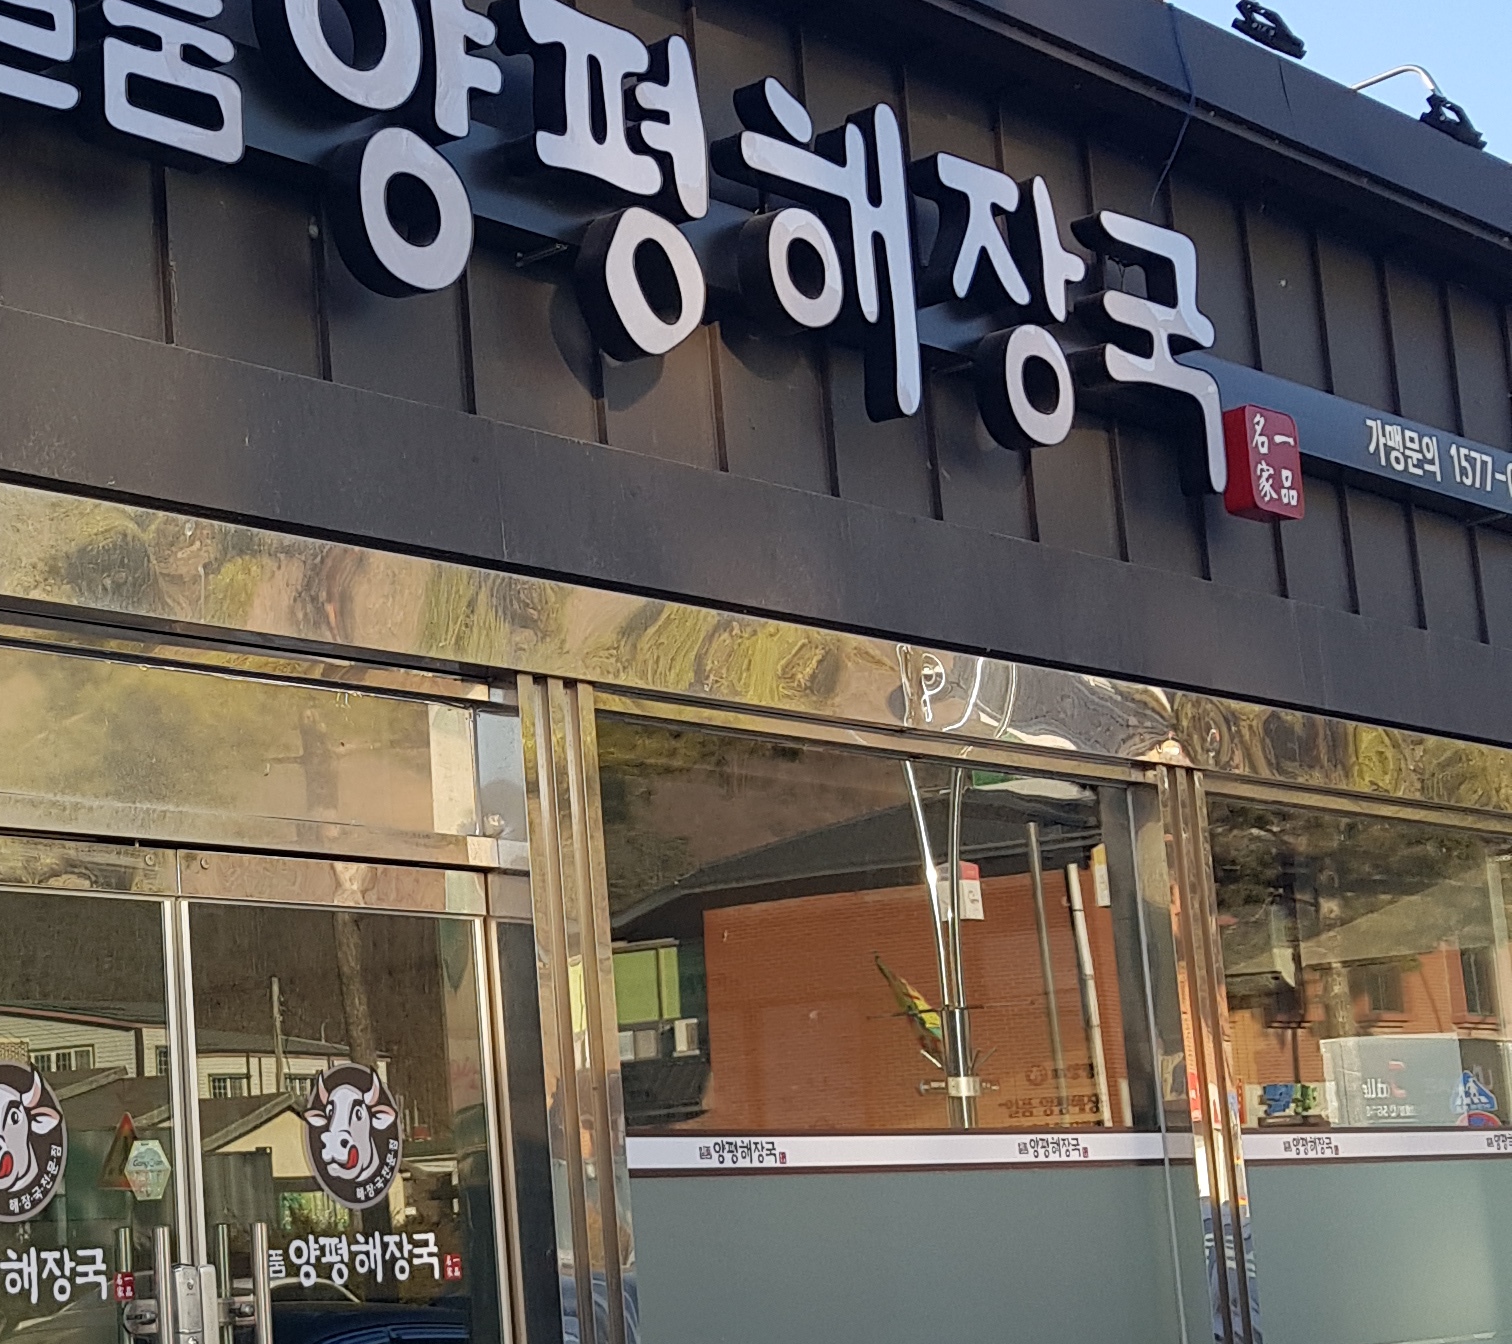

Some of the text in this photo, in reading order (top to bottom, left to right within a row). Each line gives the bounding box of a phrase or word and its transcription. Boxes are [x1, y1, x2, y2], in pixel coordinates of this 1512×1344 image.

[1365, 418, 1442, 482] 가맹문의
[713, 1140, 778, 1164] 양평해장국
[288, 1230, 440, 1288] 양평해장국
